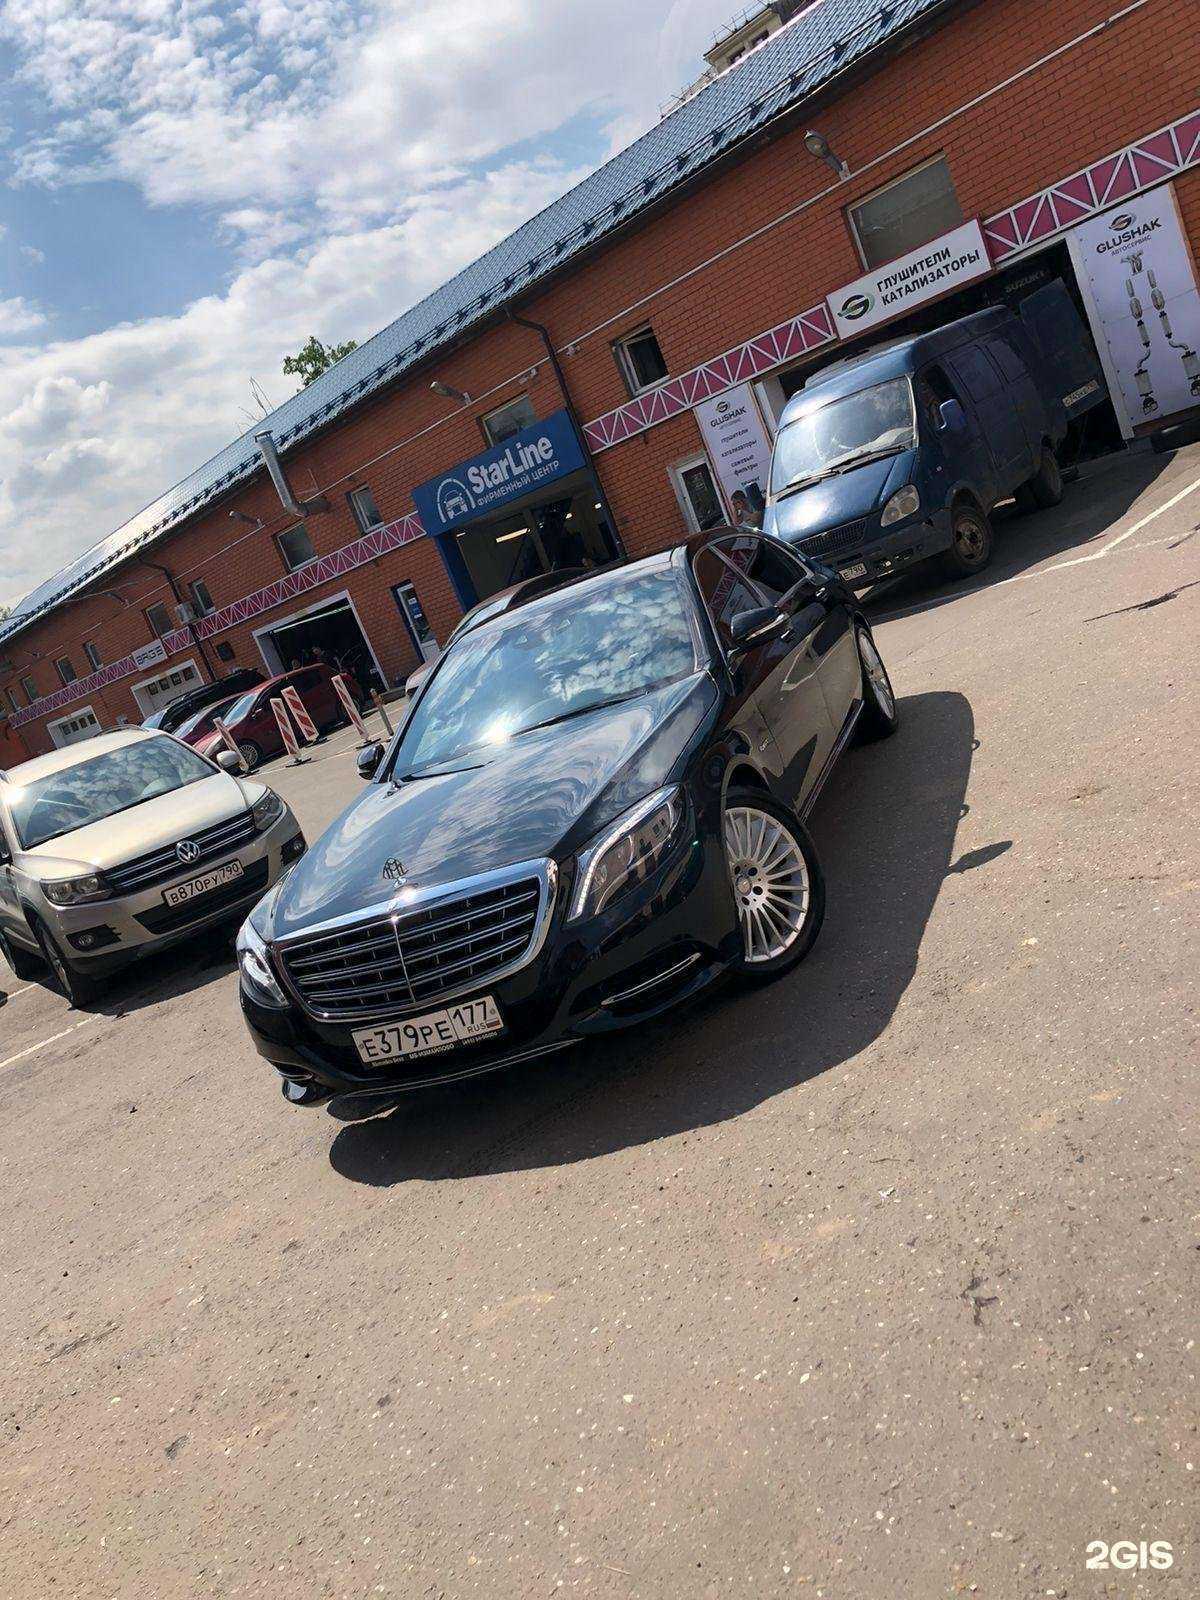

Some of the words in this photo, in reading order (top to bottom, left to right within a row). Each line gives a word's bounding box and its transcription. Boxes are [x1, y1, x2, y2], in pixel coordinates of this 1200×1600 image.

[1096, 217, 1162, 253] GLUSHAK
[876, 247, 952, 292] ГЛУШИТЕЛИ
[881, 249, 980, 306] КАТАЛИЗАТОРЫ
[710, 406, 747, 428] GLUSHAK
[467, 436, 554, 494] StarLine
[477, 473, 531, 506] ФИРМЕННЫЙ
[531, 460, 559, 481] ЦЕНТР
[452, 1001, 488, 1027] 177
[466, 1022, 487, 1034] RUS
